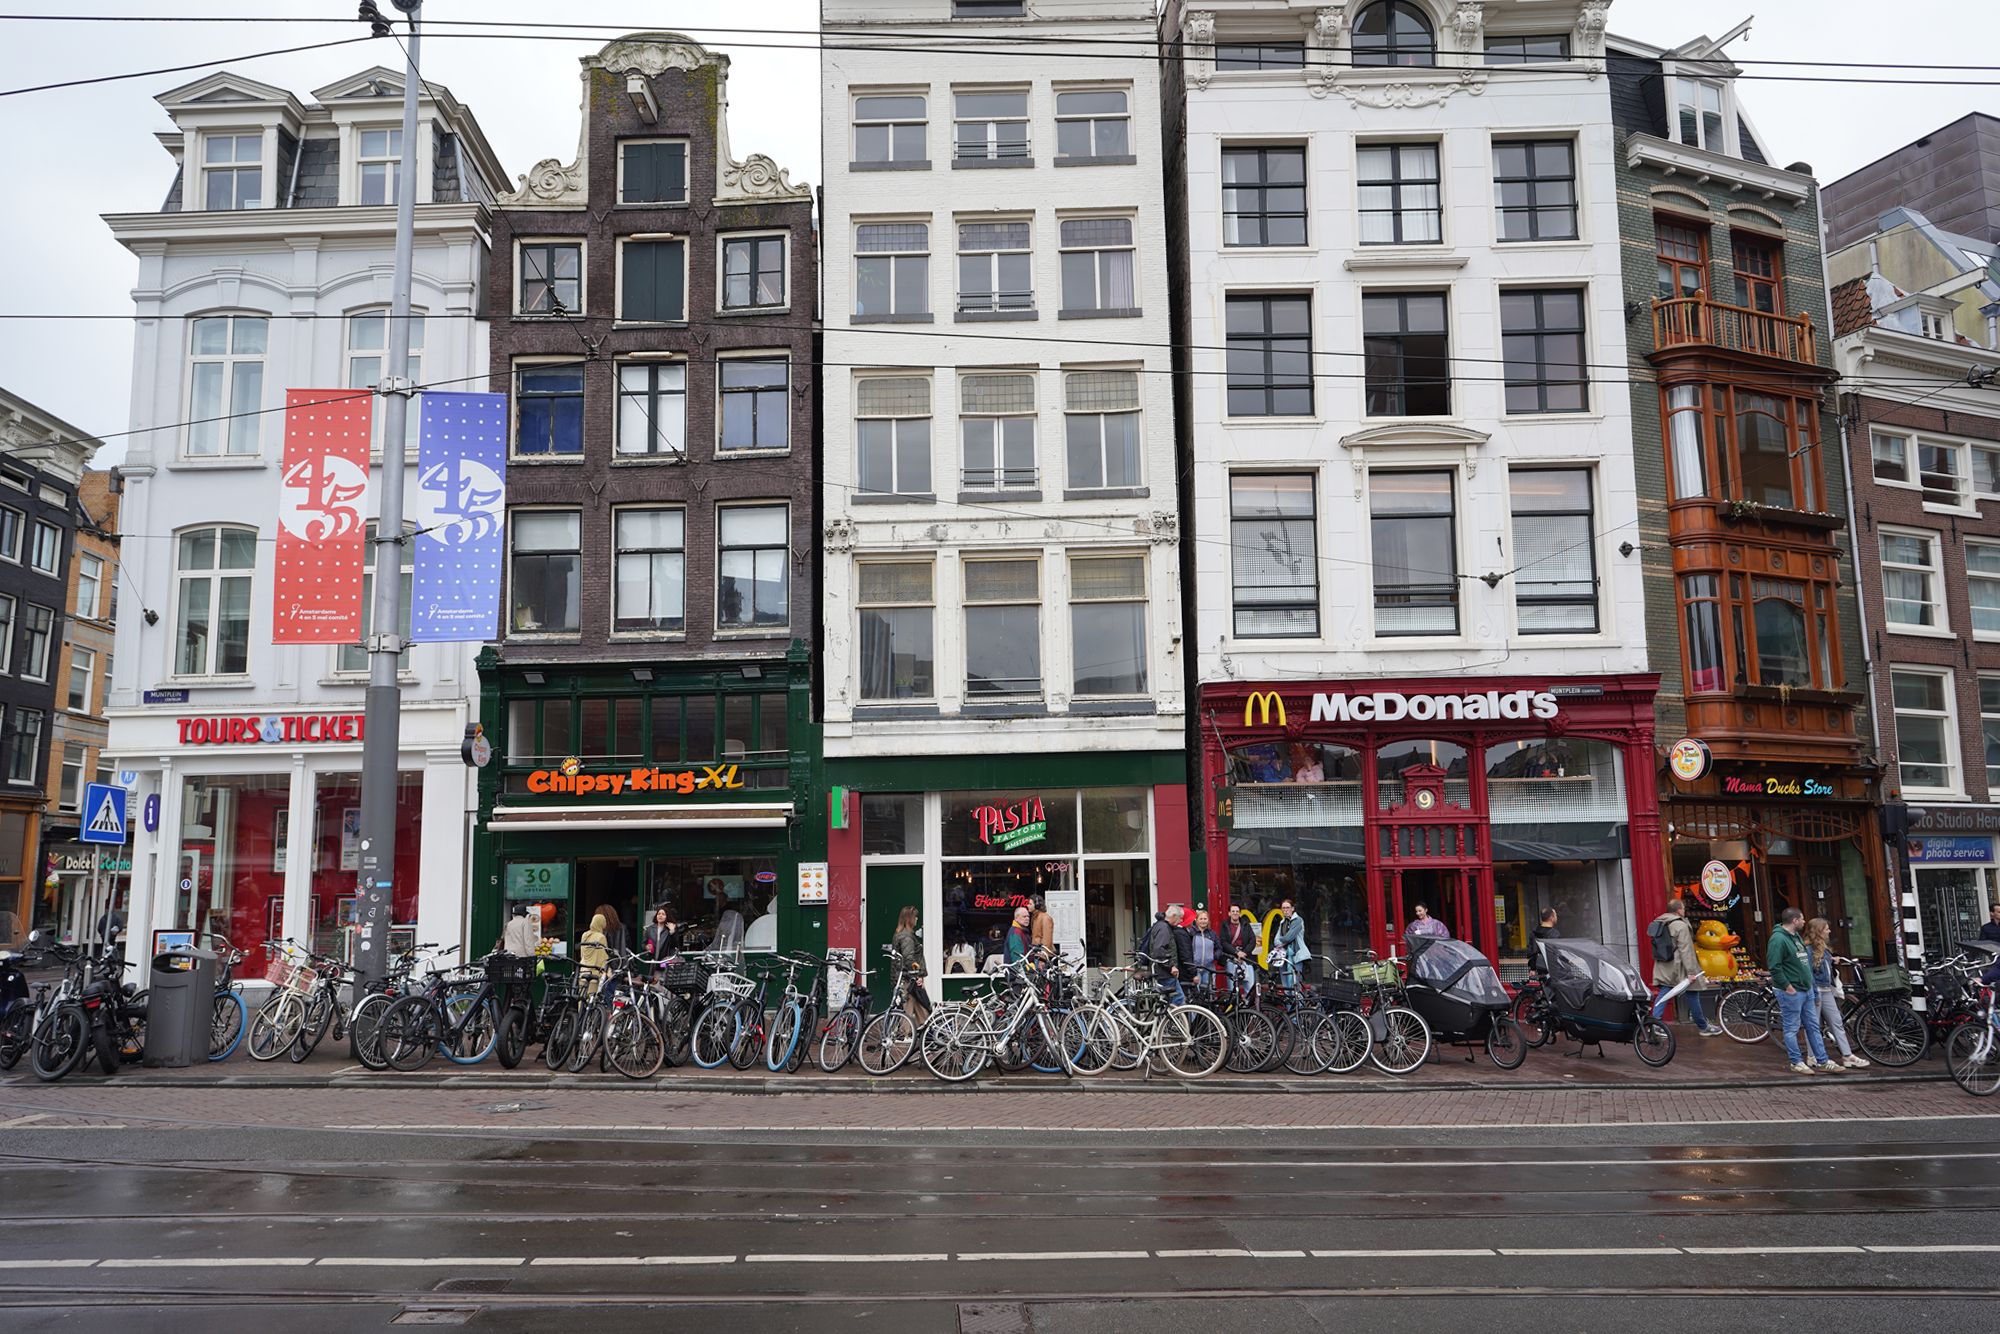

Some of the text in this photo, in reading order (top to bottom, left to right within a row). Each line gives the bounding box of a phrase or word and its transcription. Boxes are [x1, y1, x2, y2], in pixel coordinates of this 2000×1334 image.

[1310, 690, 1559, 722] McDonald's
[527, 764, 744, 795] Chipsy King XL
[1726, 776, 1833, 795] Mama Ducks Store
[1419, 790, 1430, 807] 9
[972, 796, 1046, 845] PASTA
[1936, 812, 1973, 828] Studio
[997, 822, 1043, 843] FACTORY
[1006, 833, 1044, 849] AMSTERDAM
[1928, 838, 1955, 850] digital
[1926, 848, 1985, 860] photo service
[491, 876, 498, 884] 5
[975, 895, 1006, 910] Home
[1712, 904, 1728, 912] Ducks
